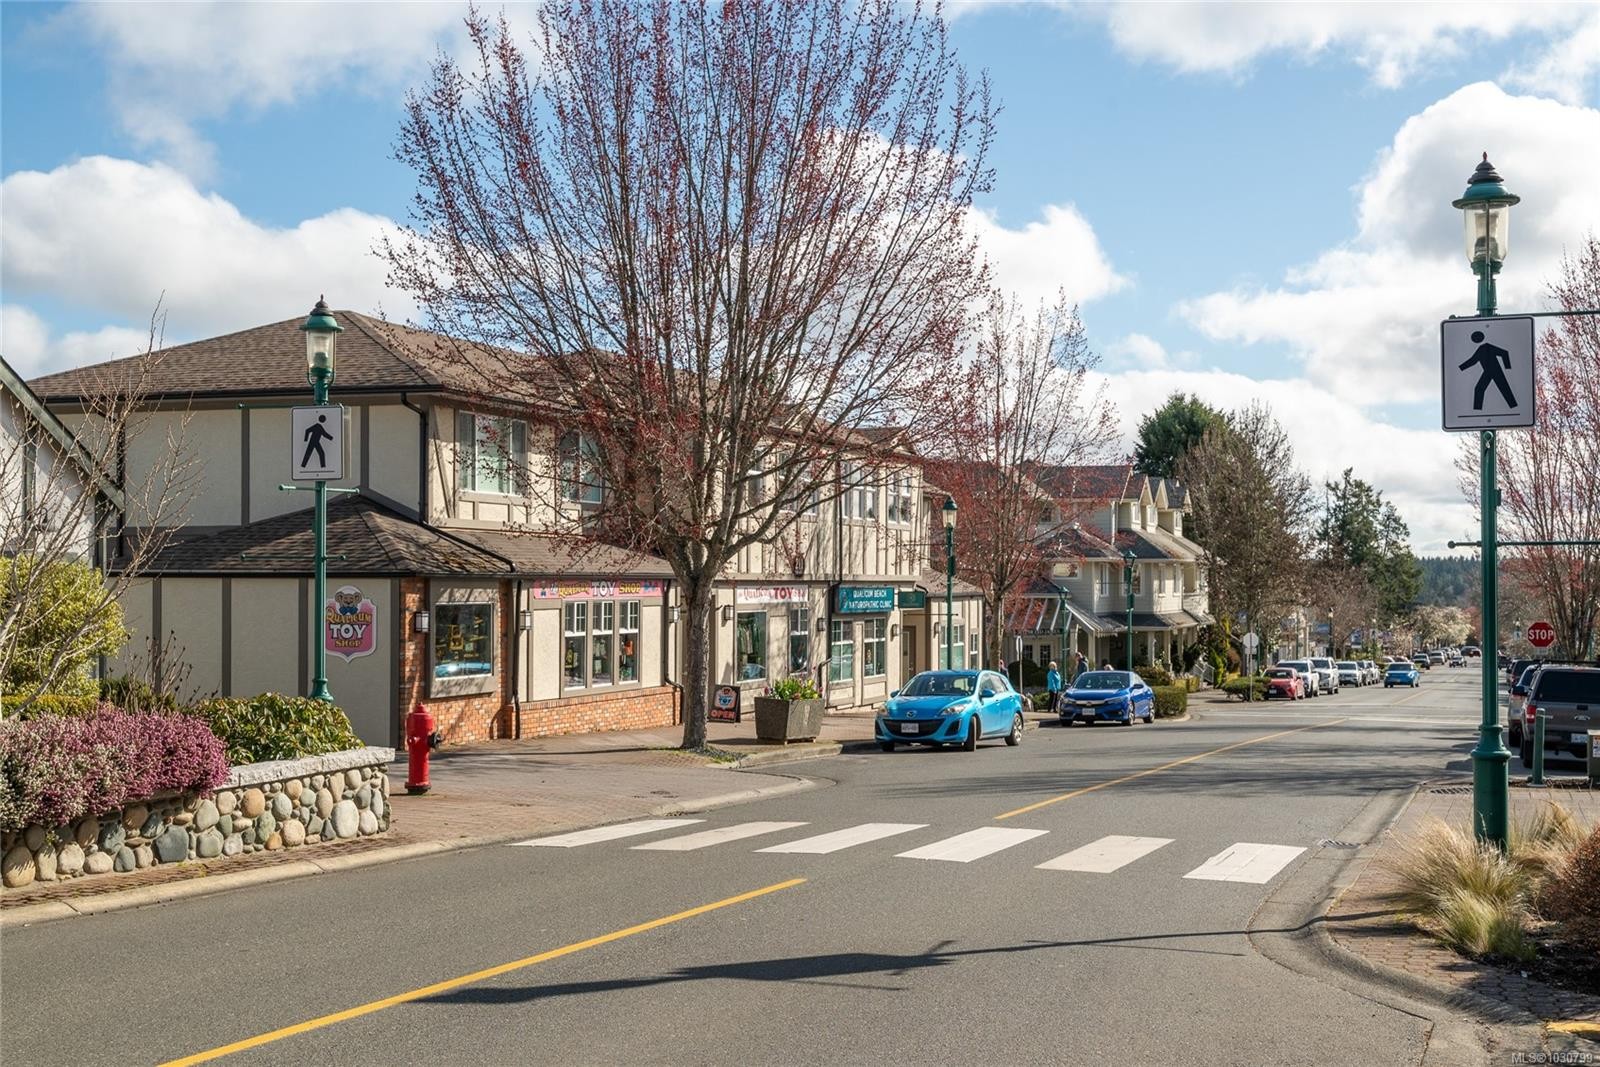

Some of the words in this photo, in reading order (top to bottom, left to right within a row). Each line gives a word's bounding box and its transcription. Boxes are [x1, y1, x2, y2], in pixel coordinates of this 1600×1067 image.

[592, 581, 616, 597] TOY
[619, 582, 641, 594] SHOP
[773, 587, 794, 600] TOY
[874, 589, 887, 598] BEACH
[329, 624, 368, 640] TOY
[1528, 629, 1554, 640] STOP
[335, 640, 362, 648] SHOP
[710, 709, 737, 719] OPEN
